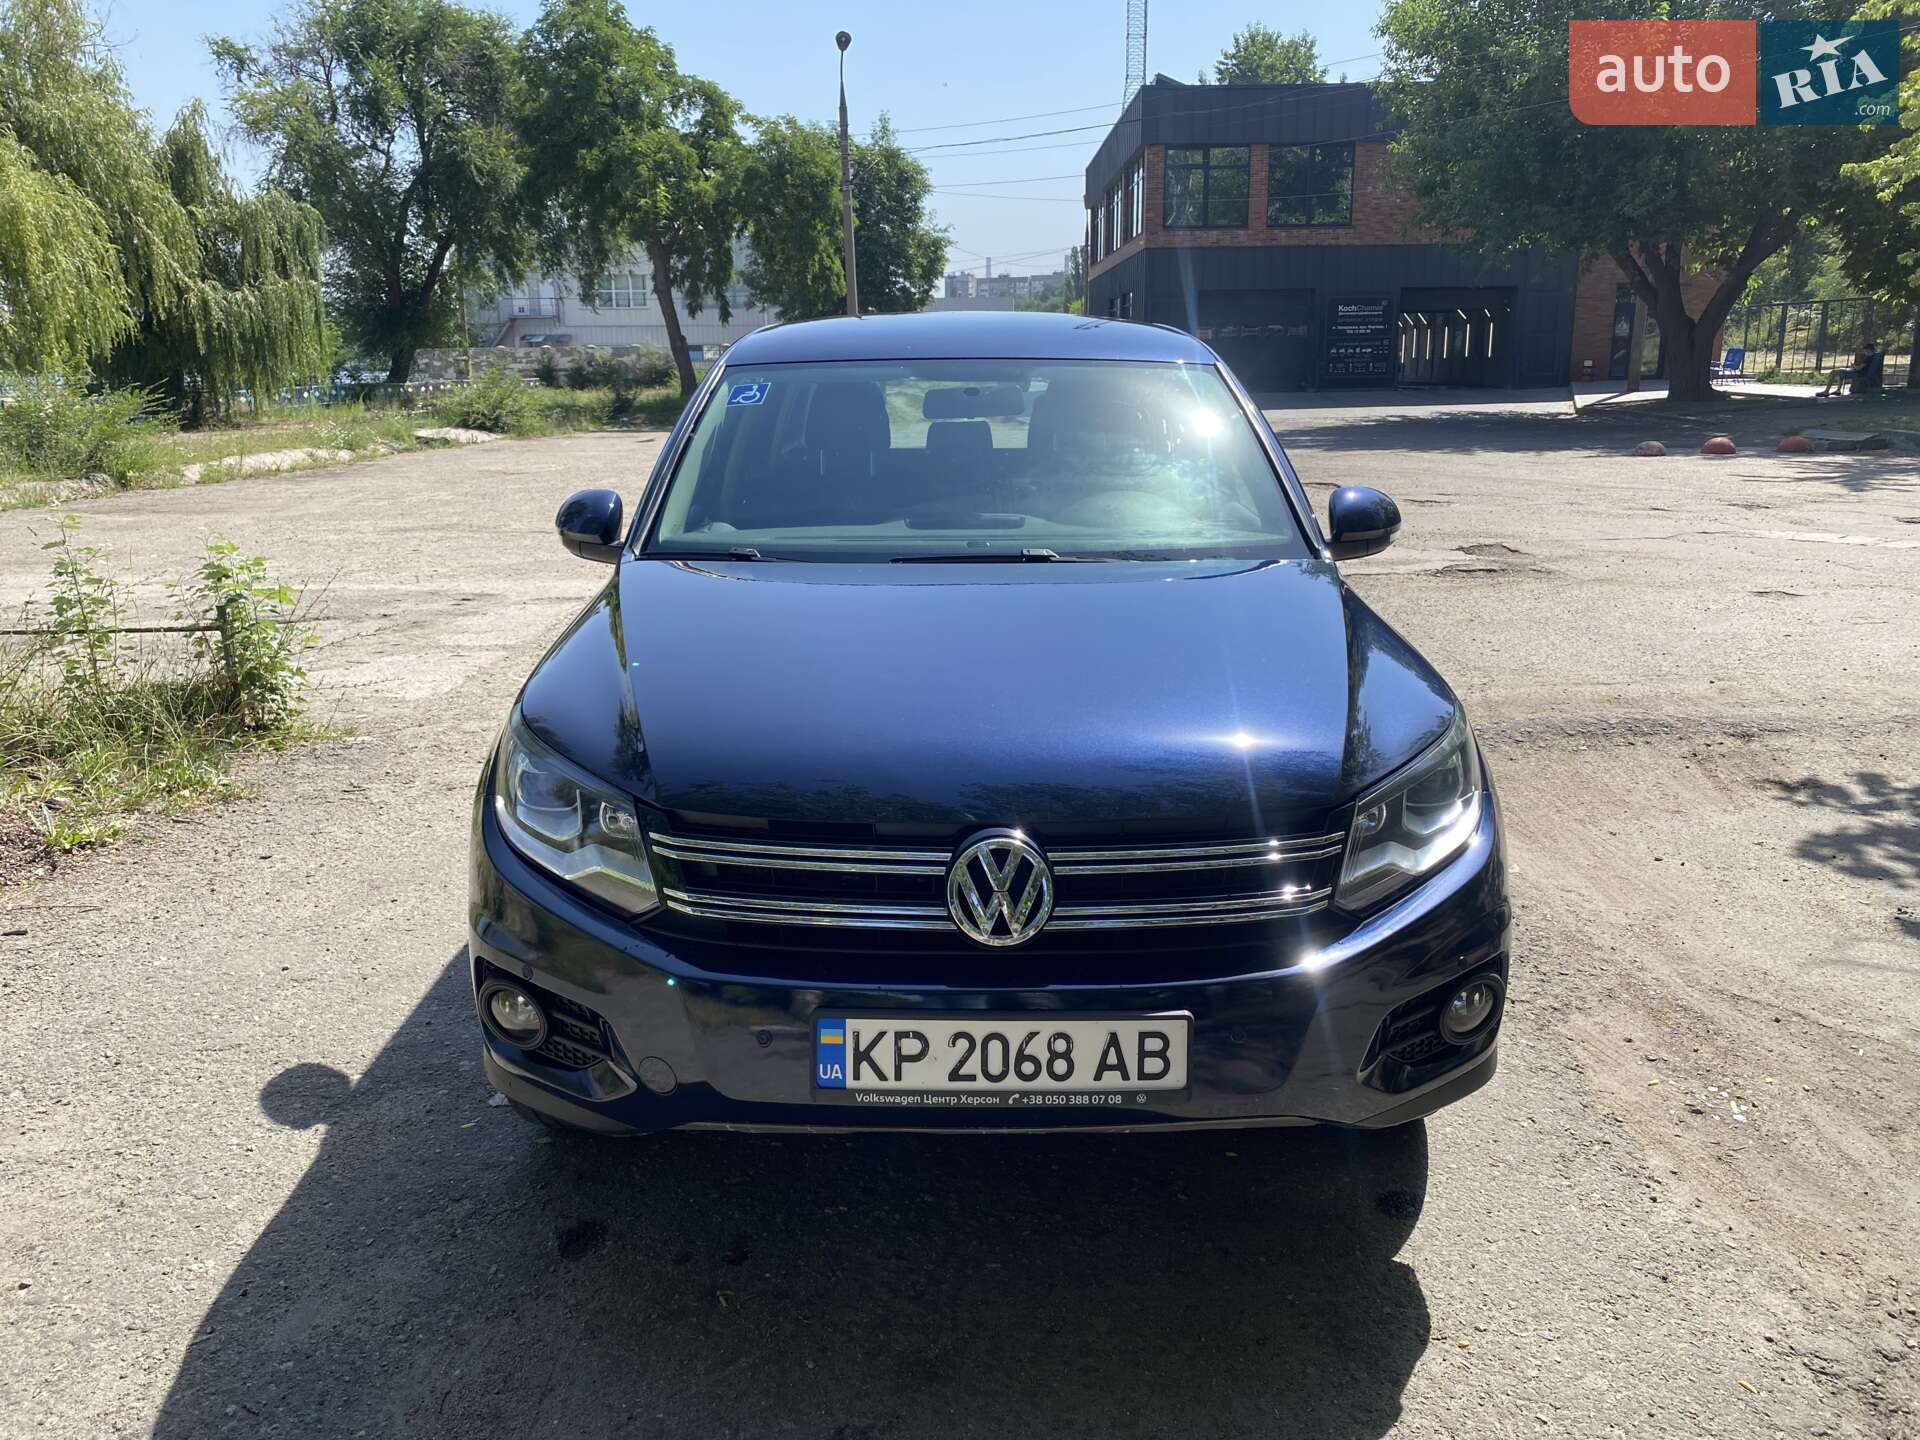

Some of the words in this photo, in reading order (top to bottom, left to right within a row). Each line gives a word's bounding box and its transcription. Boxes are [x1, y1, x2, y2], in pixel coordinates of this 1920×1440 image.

[852, 1031, 930, 1082] KP
[947, 1031, 1075, 1083] 2068
[1093, 1031, 1171, 1082] AB
[819, 1063, 843, 1080] UA
[855, 1092, 921, 1105] Volkswagen
[923, 1094, 958, 1106] Центр
[960, 1094, 1000, 1106] Херсон
[1022, 1095, 1043, 1105] +38
[1045, 1095, 1066, 1105] 050
[1068, 1095, 1089, 1105] 388
[1091, 1095, 1105, 1105] 07
[1107, 1094, 1122, 1104] 08
